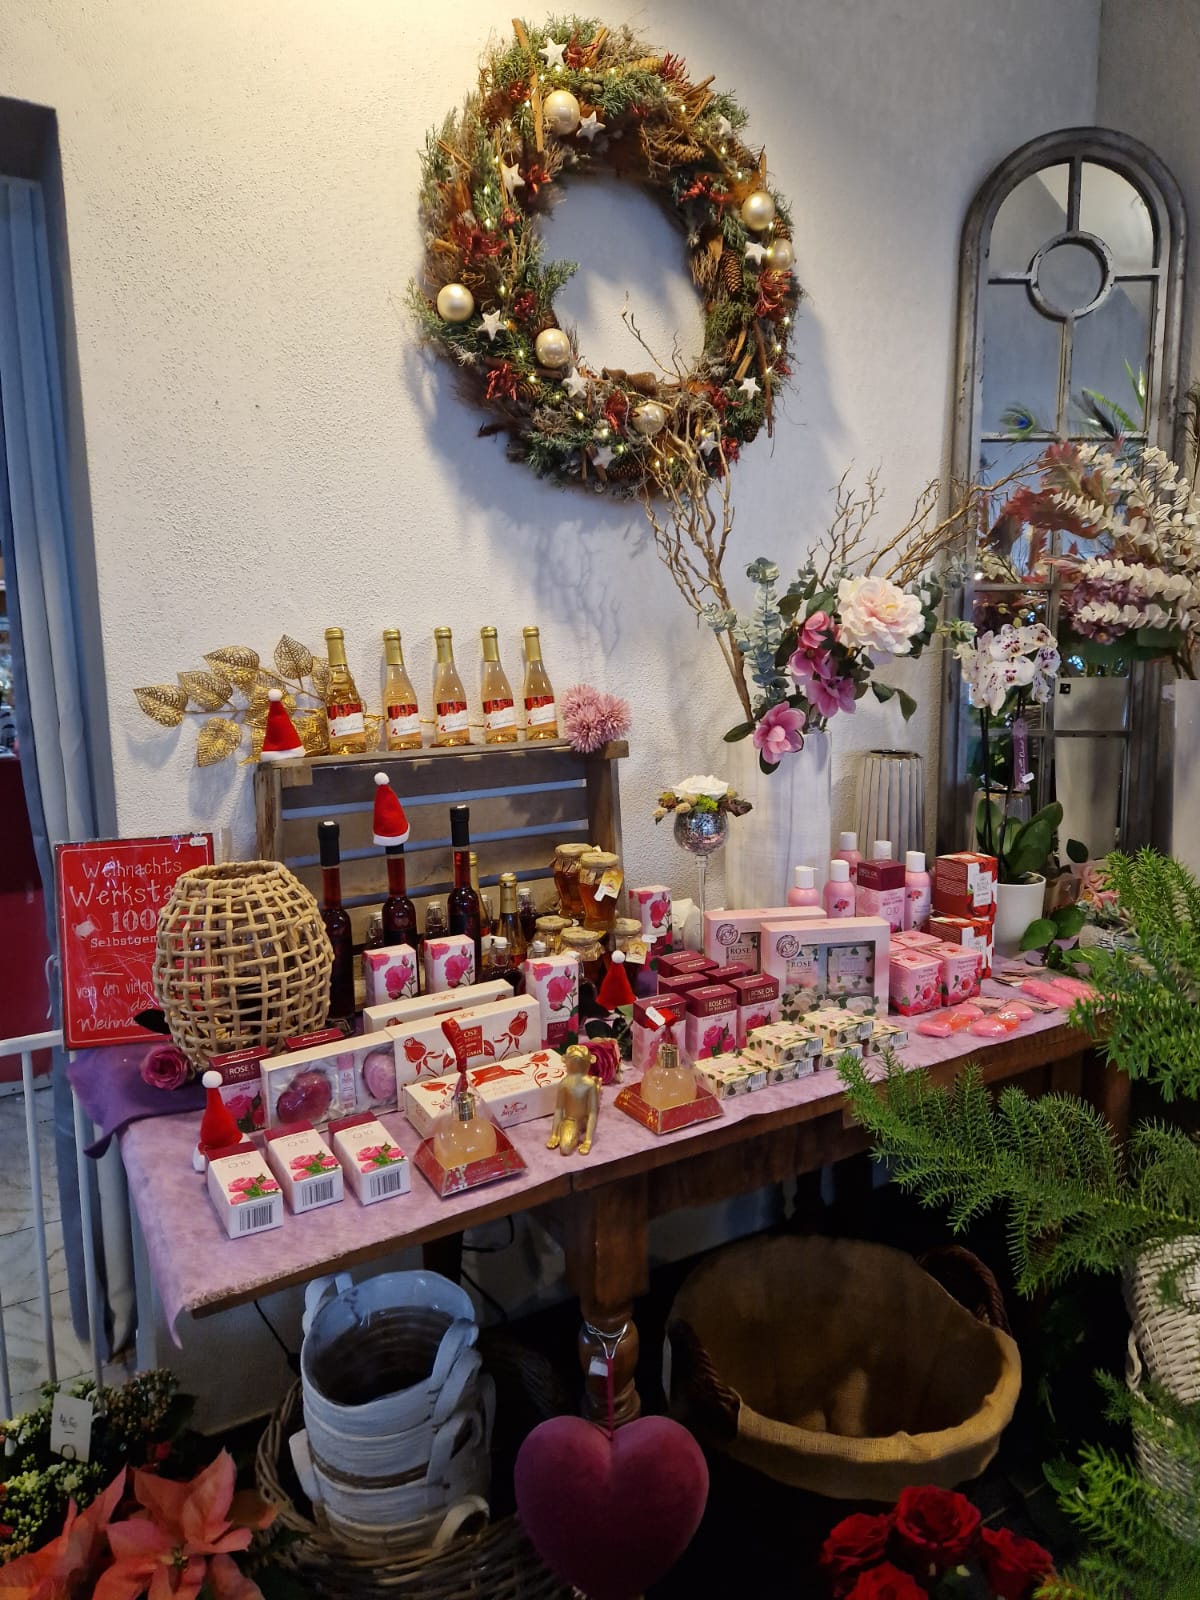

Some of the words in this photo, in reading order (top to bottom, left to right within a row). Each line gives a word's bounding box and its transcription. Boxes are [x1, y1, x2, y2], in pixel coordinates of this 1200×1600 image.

[69, 880, 175, 906] Werksta
[110, 908, 157, 933] 100
[90, 935, 157, 948] Selbstgem
[791, 960, 812, 968] ROSE
[131, 997, 154, 1012] des
[76, 1015, 139, 1033] Weihna
[229, 1065, 249, 1075] ROSE
